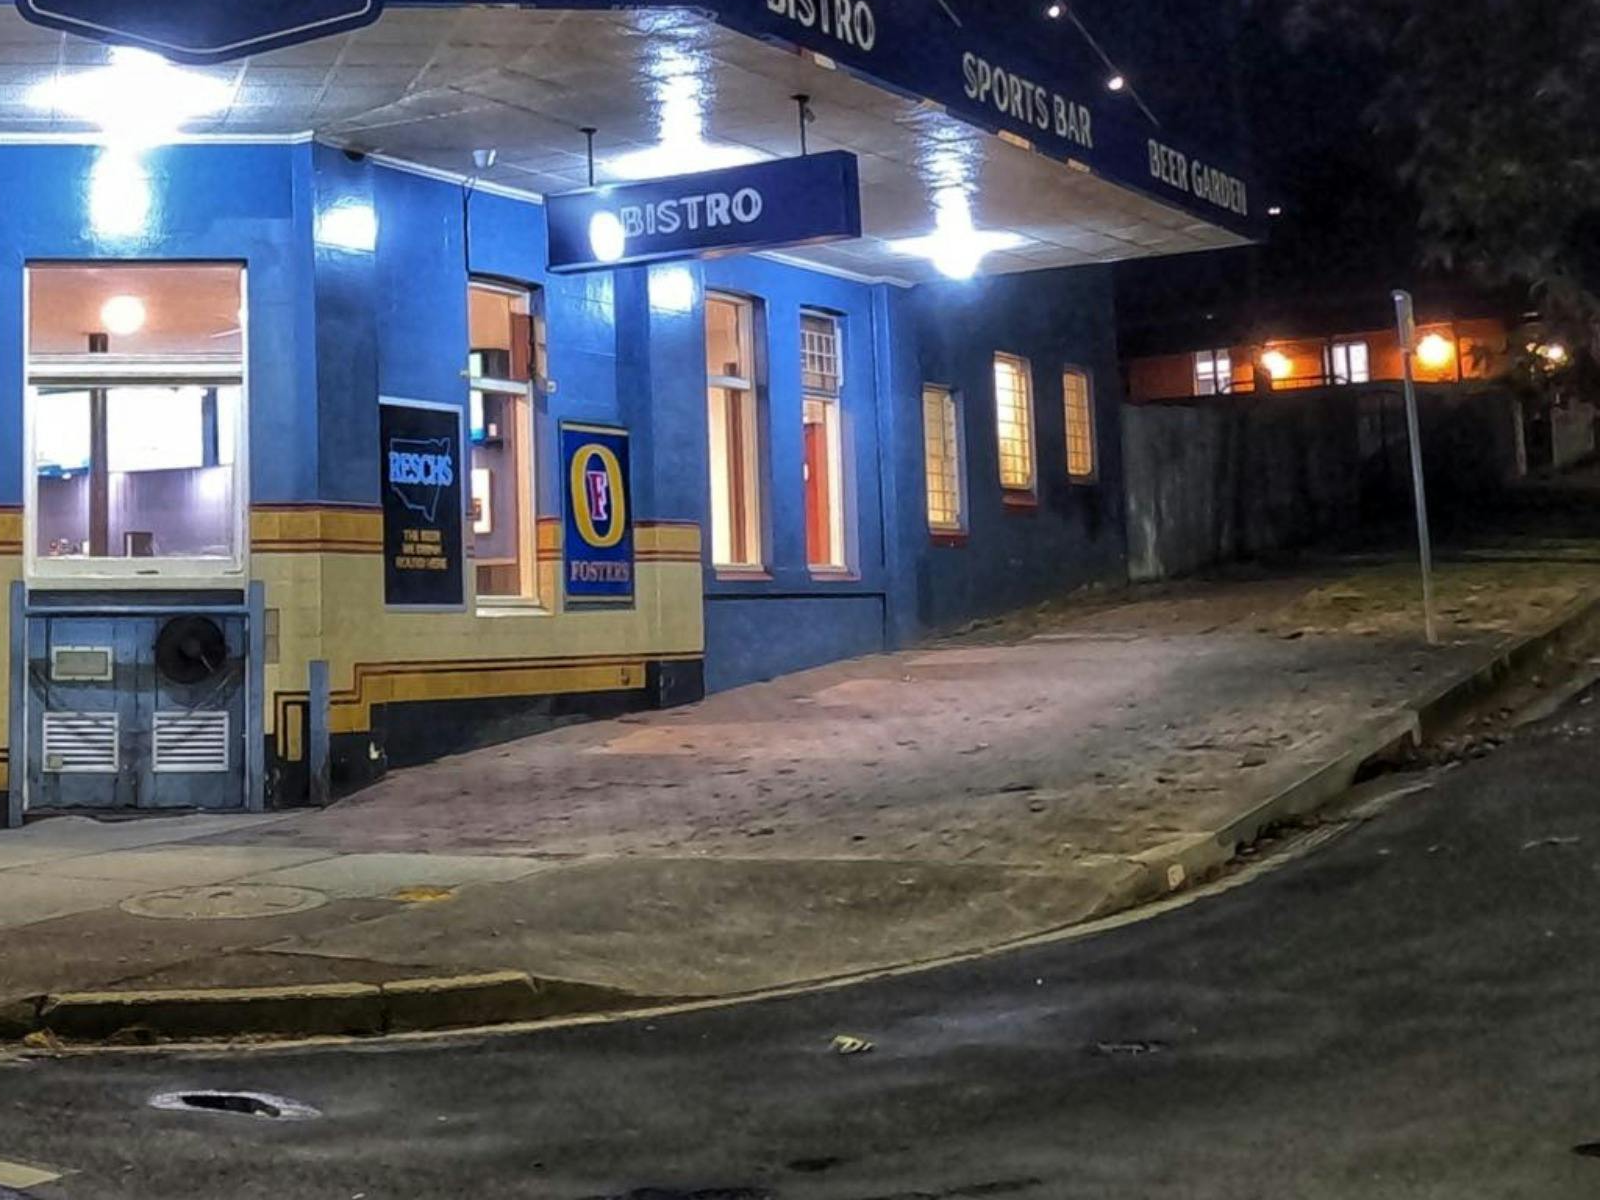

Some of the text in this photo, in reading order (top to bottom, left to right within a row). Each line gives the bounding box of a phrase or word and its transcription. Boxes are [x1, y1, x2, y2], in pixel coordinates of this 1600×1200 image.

[962, 52, 1094, 149] SPORTS BAR
[1147, 138, 1248, 216] BEER GARDEN
[619, 187, 763, 238] BISTRO
[388, 450, 454, 487] RESCHS
